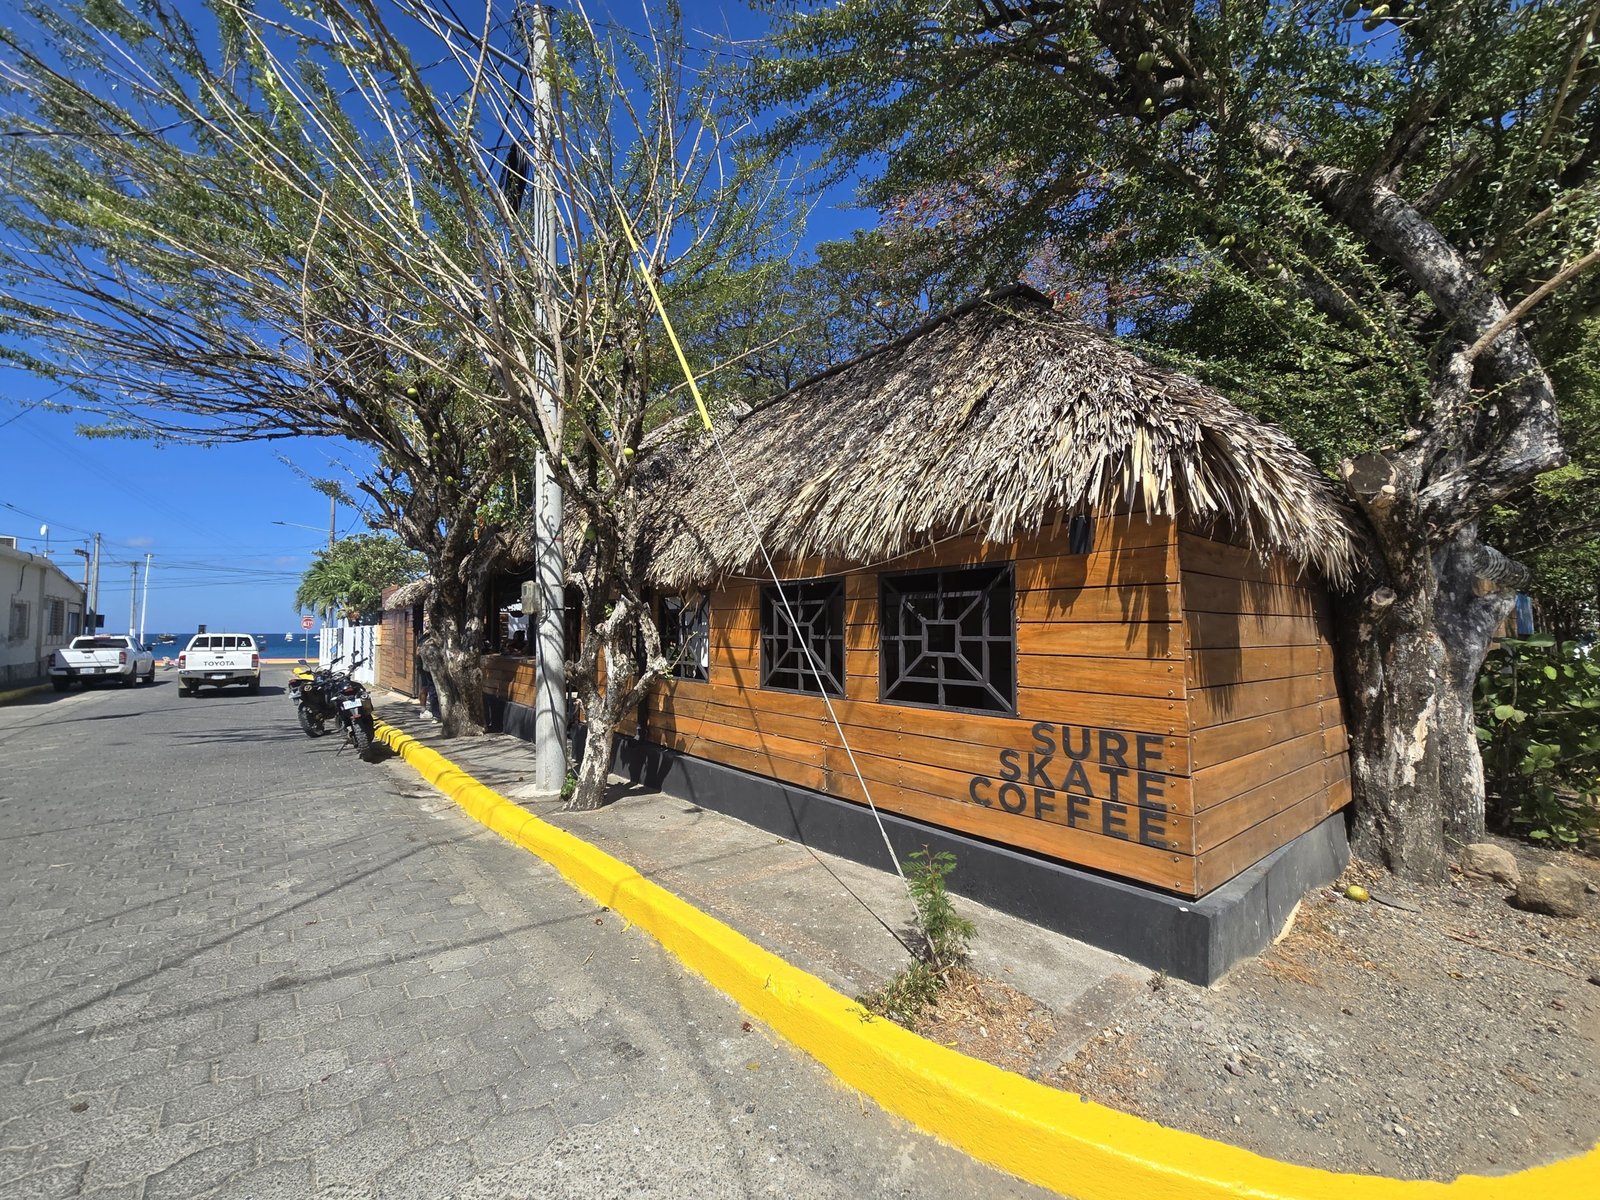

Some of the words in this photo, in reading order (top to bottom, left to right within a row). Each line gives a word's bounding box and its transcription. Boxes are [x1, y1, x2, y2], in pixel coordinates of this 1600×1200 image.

[1031, 722, 1164, 770] SURF
[969, 776, 1167, 848] COFFEE
[999, 749, 1167, 812] SKATE
